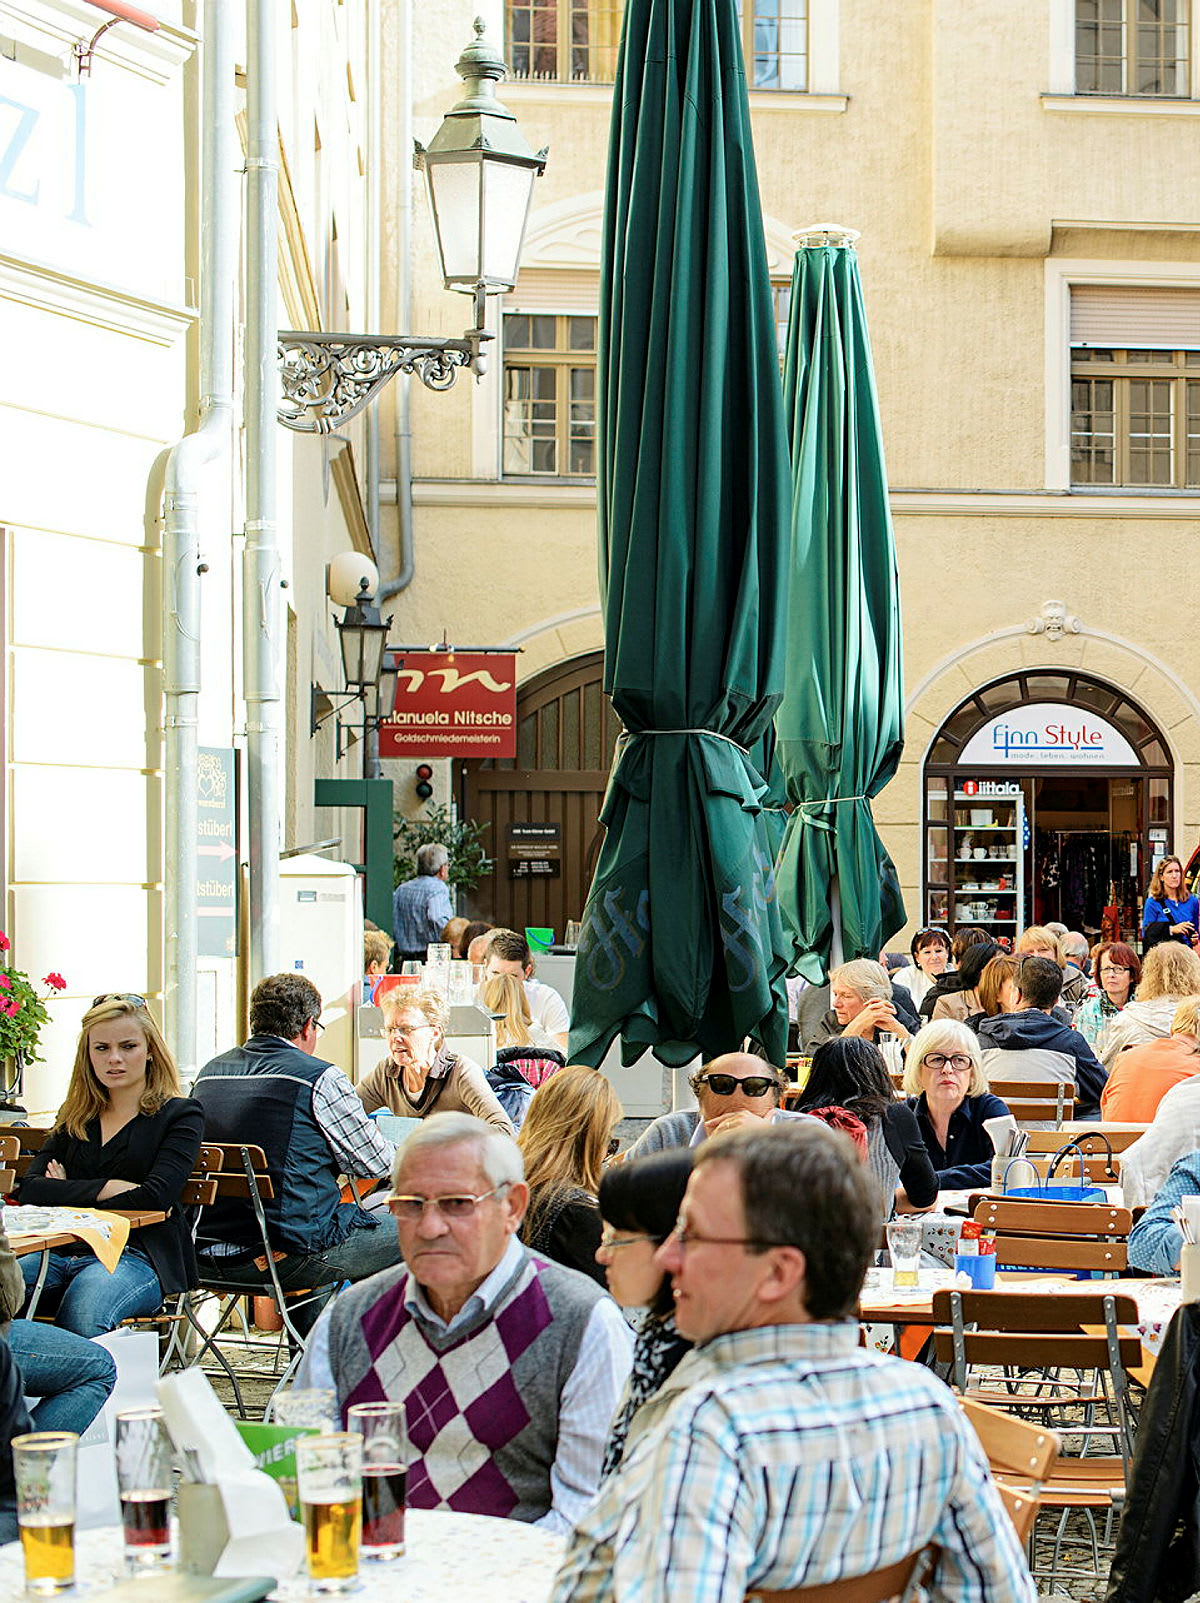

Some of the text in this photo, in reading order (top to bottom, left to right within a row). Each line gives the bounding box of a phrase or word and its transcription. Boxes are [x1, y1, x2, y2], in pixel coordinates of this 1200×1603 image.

[454, 710, 512, 725] Nitsche
[393, 732, 501, 744] Goldschmiedemeisterin
[1045, 725, 1102, 750] Style
[978, 781, 1020, 795] iittala
